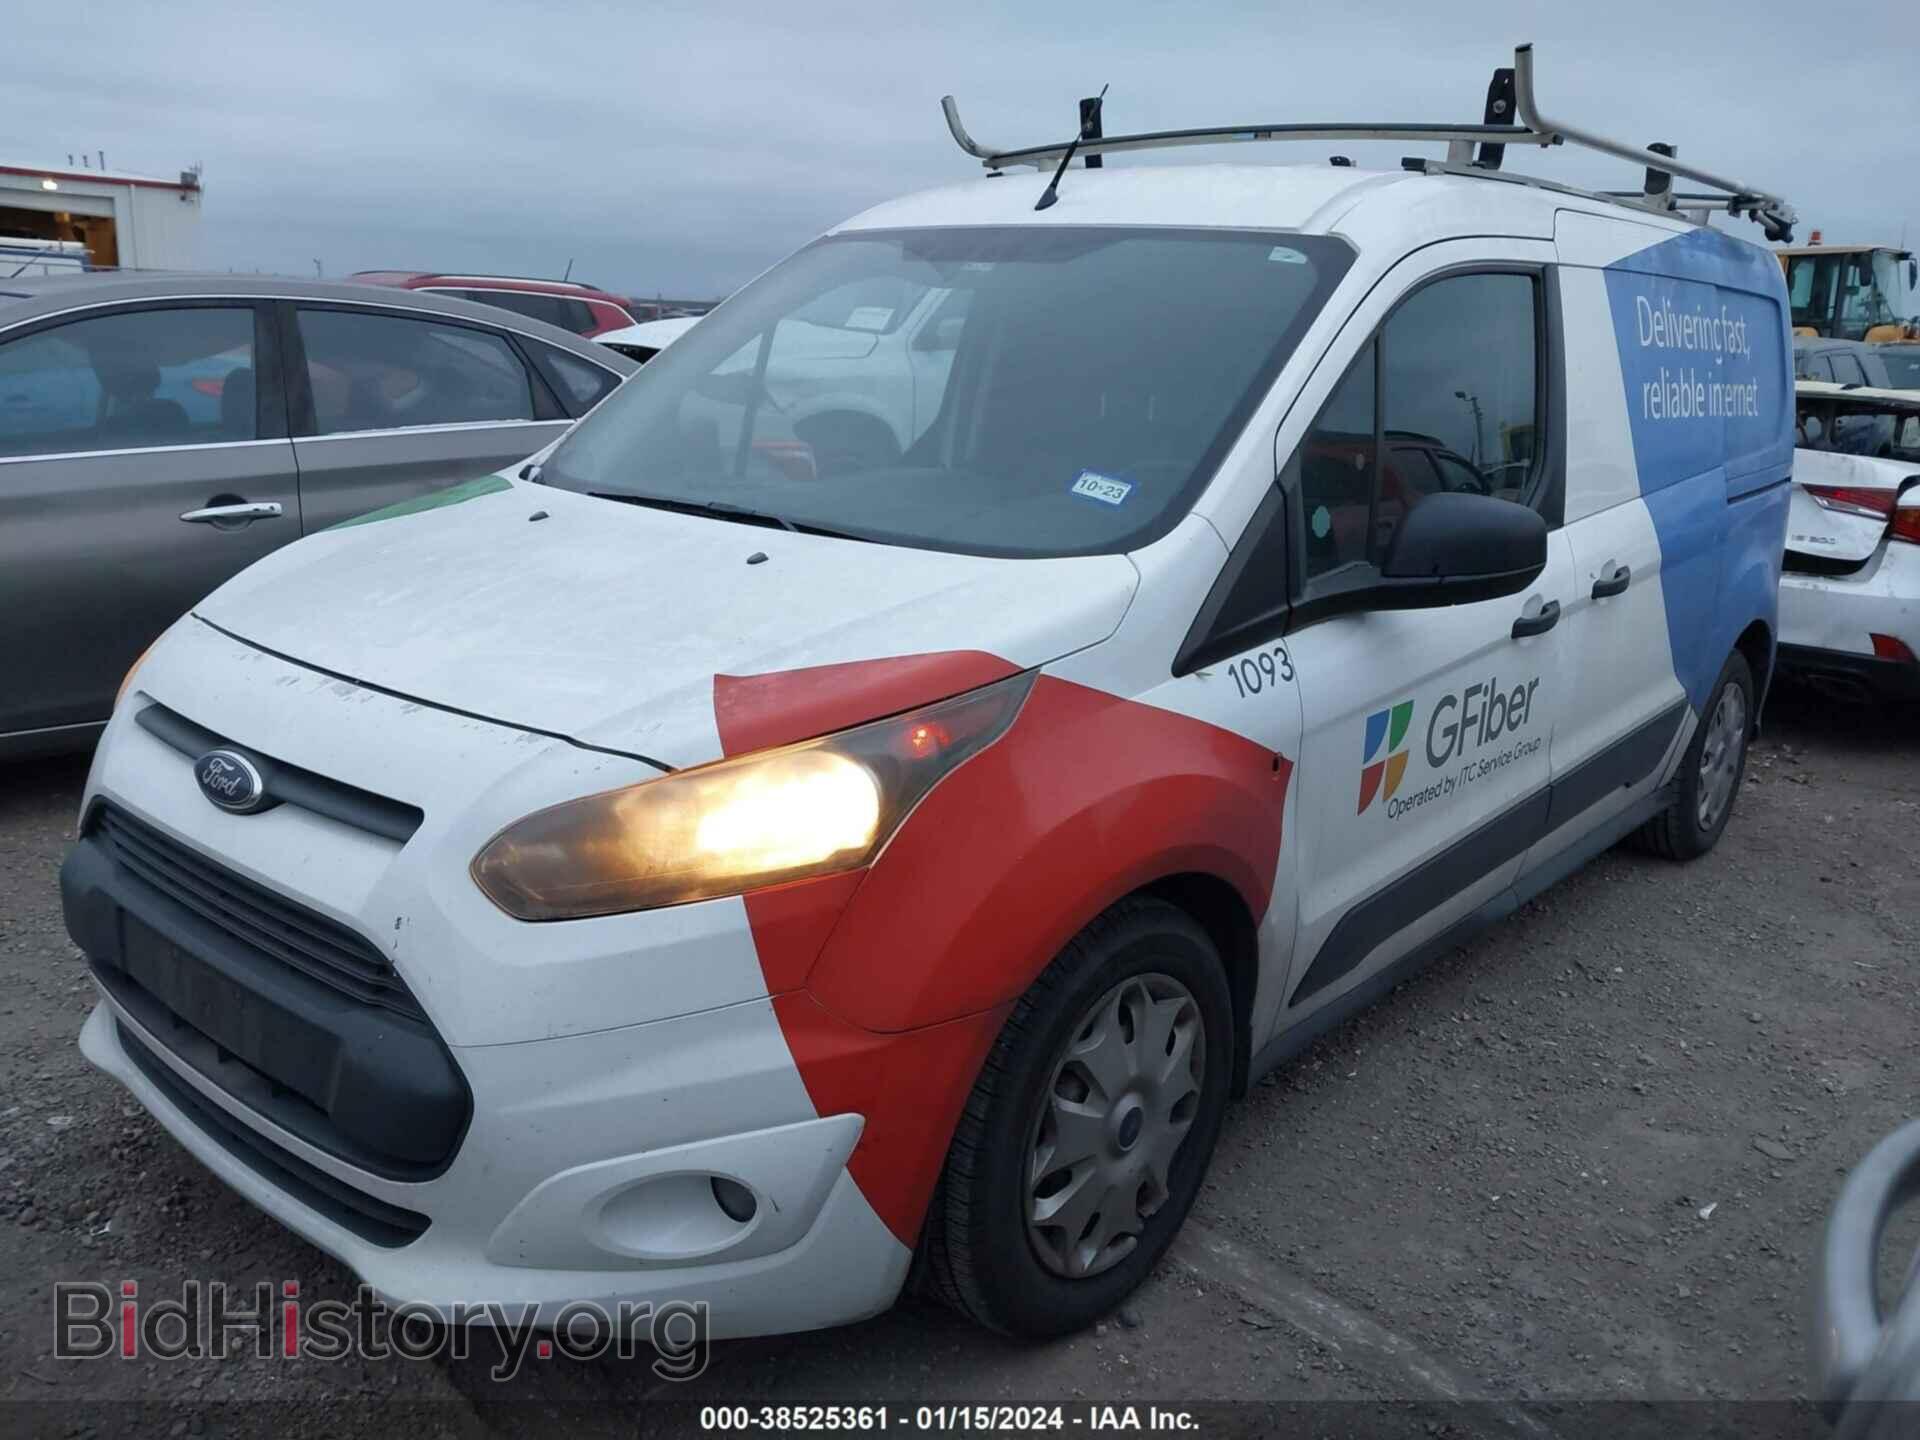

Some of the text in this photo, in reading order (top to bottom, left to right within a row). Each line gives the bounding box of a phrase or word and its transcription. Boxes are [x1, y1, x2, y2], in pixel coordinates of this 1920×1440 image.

[1636, 295, 1751, 365] Delivering fast,
[1643, 367, 1705, 419] reliable
[1228, 647, 1294, 698] 1093
[1426, 676, 1540, 769] GFiber
[202, 757, 242, 796] Ford
[1387, 737, 1542, 821] Operated by ITC Service Group
